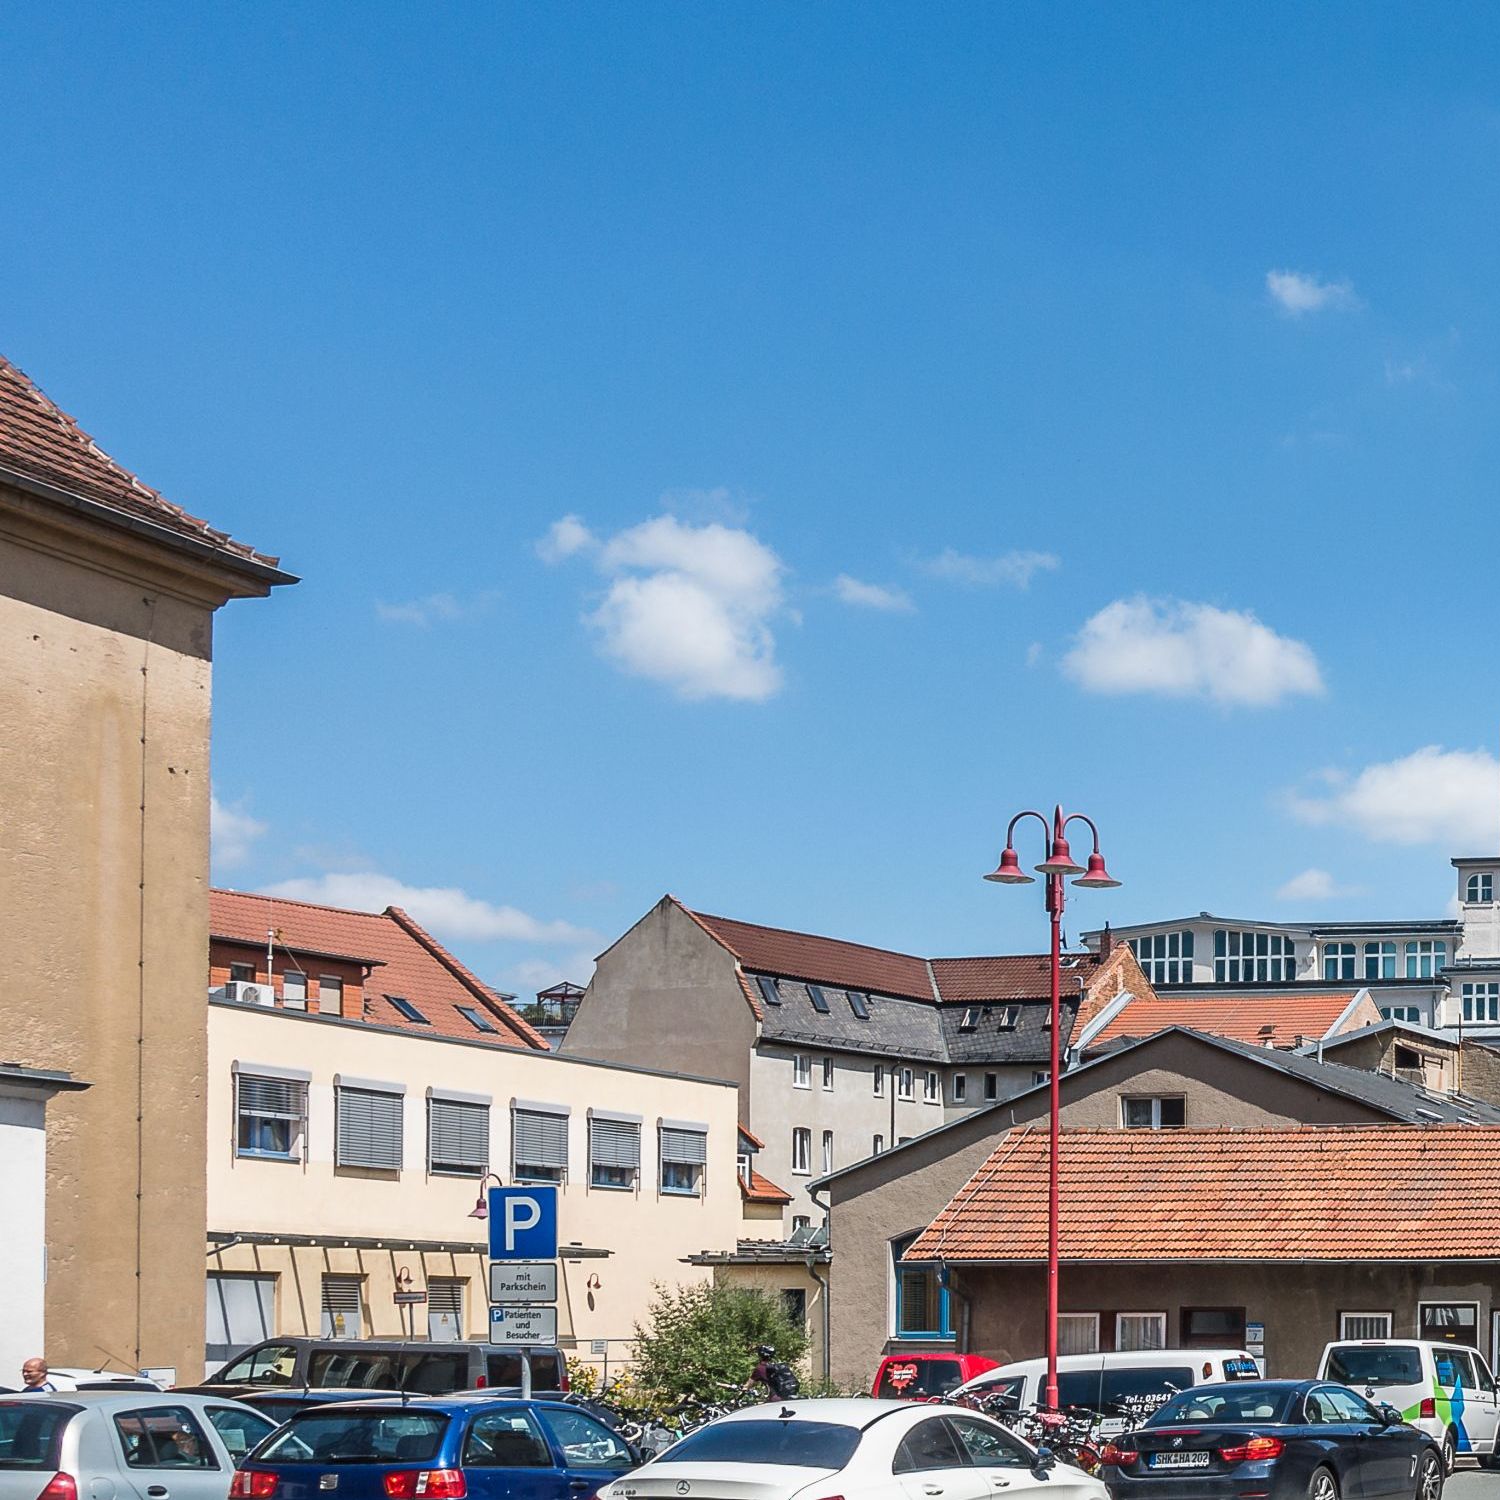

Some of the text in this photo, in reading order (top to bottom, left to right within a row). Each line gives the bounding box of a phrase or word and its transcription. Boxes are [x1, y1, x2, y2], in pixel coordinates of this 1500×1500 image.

[505, 1196, 541, 1250] P
[516, 1272, 531, 1281] mit
[500, 1282, 547, 1291] Parkschein
[493, 1310, 502, 1321] P
[505, 1311, 541, 1319] Patienten
[515, 1321, 531, 1329] und
[506, 1331, 540, 1339] Besucher
[1156, 1453, 1208, 1464] SHK HA 202
